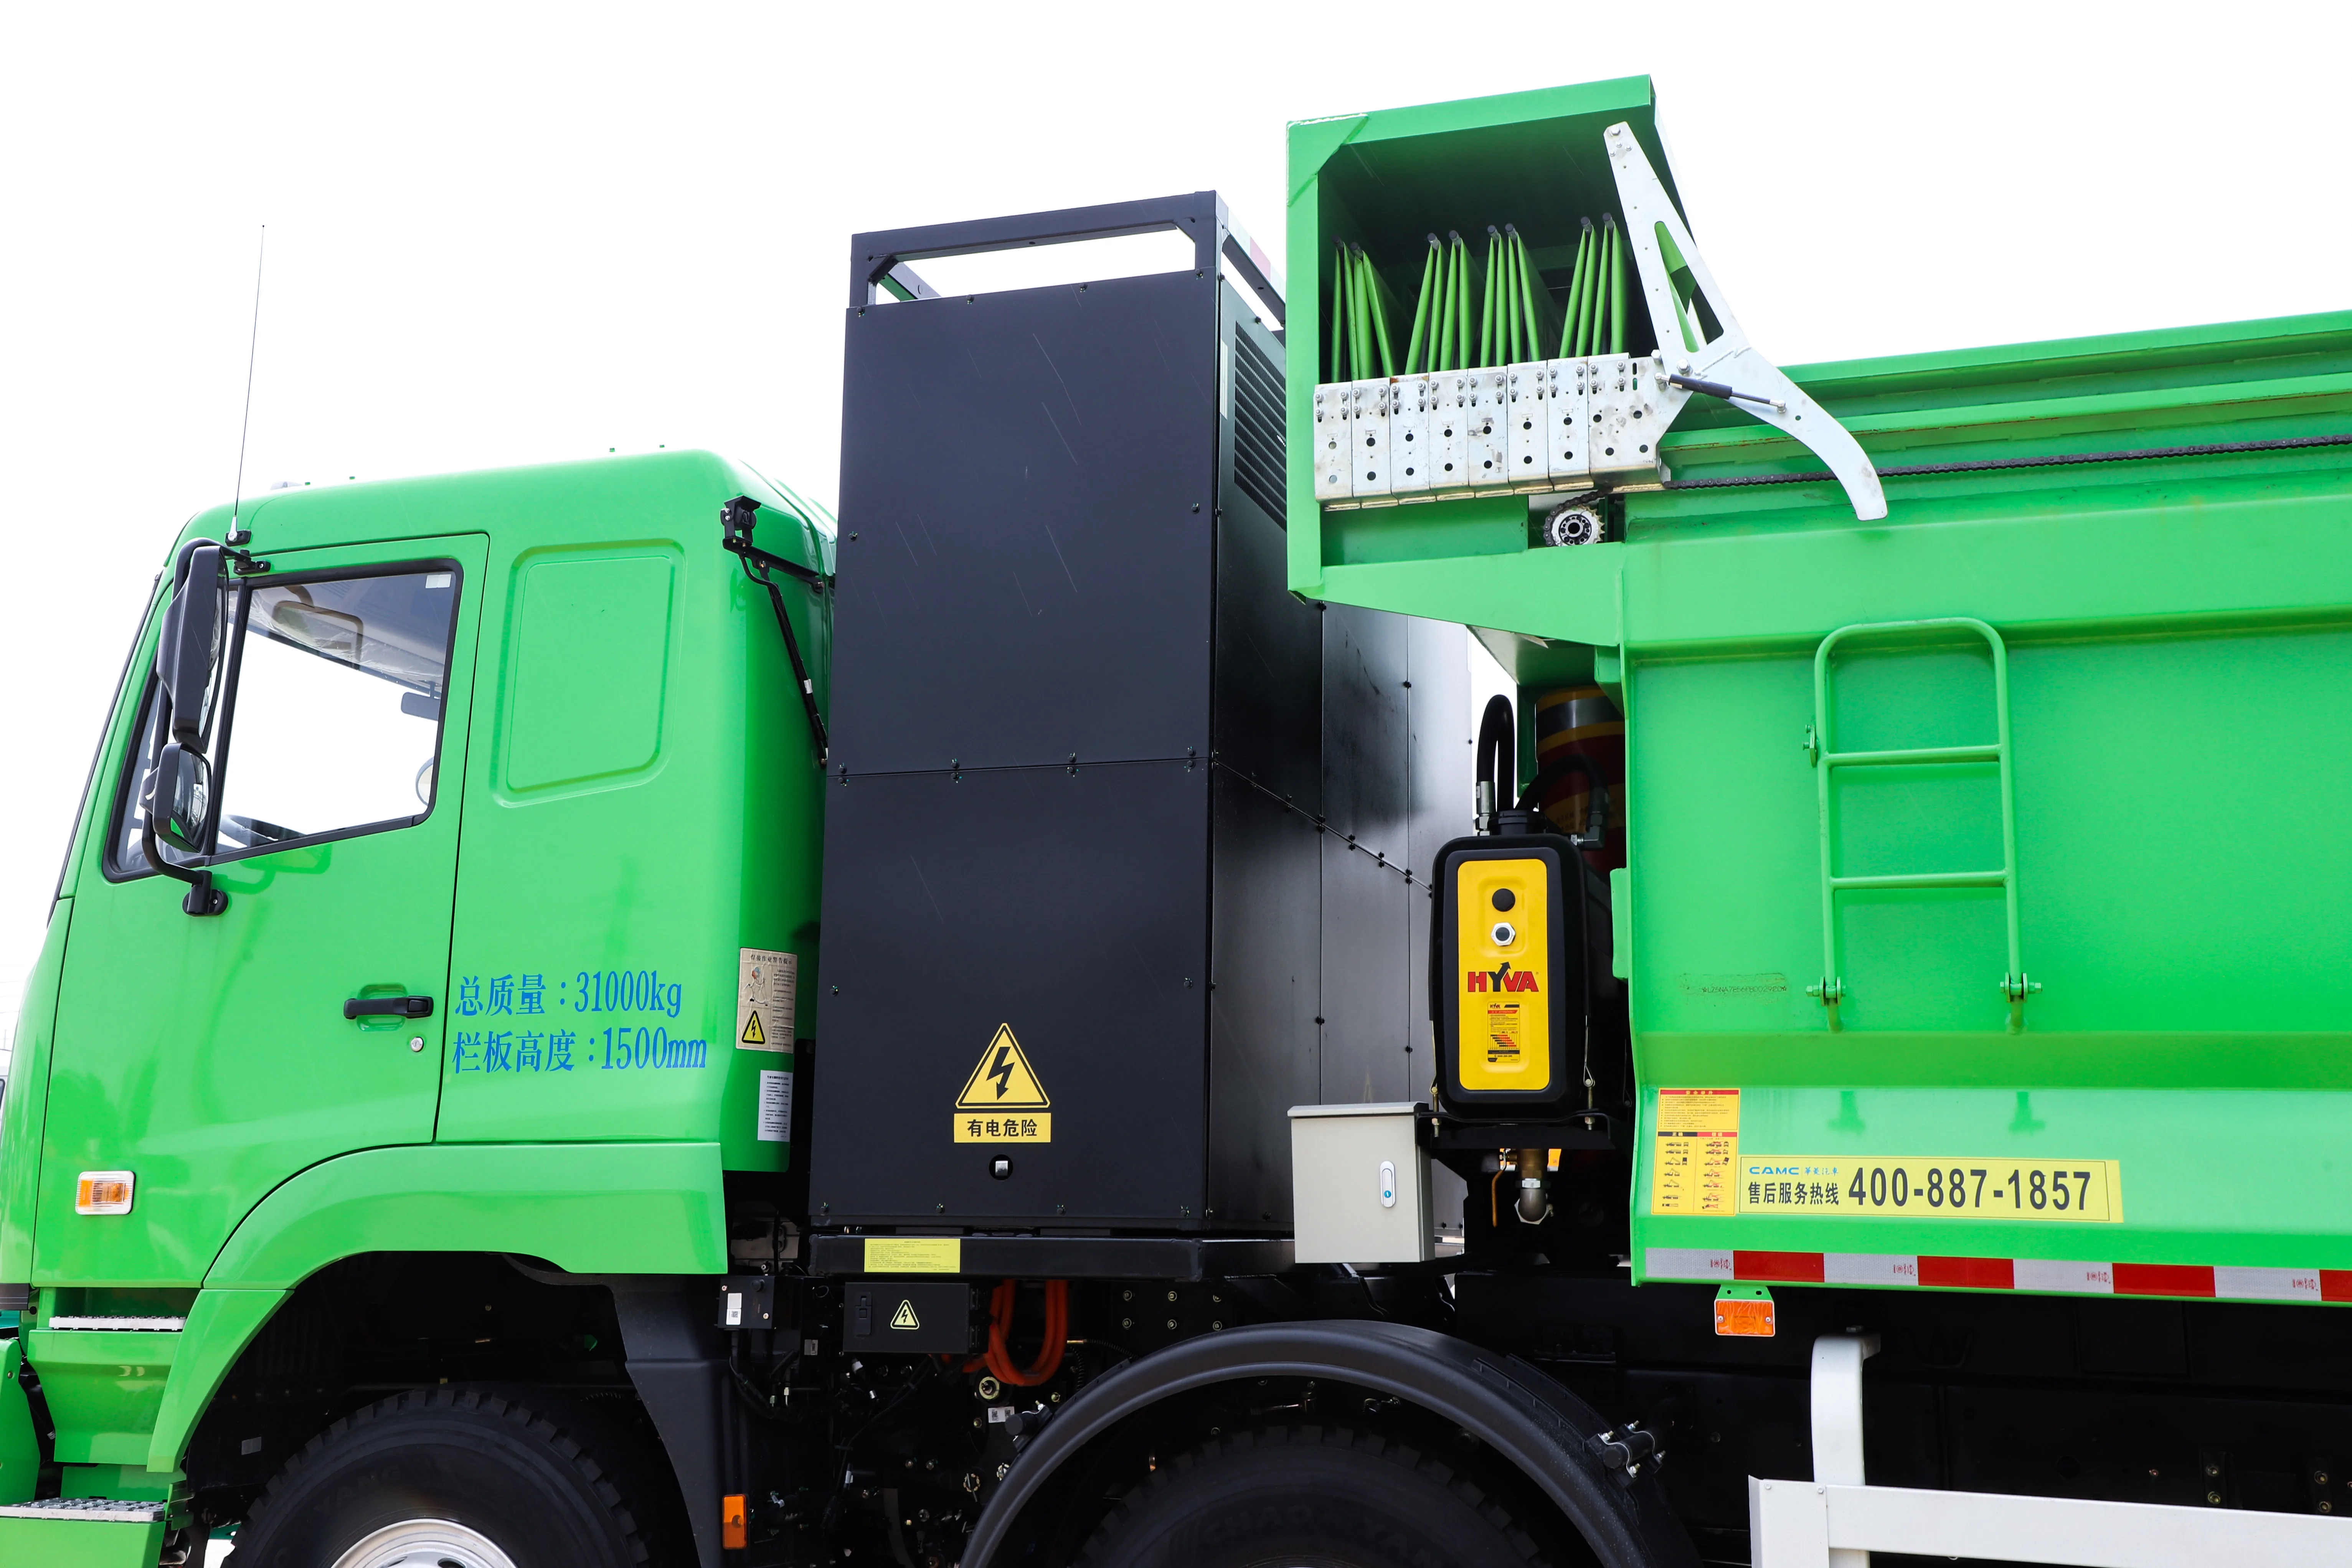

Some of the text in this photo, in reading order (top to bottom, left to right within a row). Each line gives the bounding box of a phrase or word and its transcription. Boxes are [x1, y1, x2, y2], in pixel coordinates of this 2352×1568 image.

[750, 954, 792, 965] 焊接作业警告提示
[1467, 962, 1539, 992] HYVA
[967, 1119, 1038, 1137] 有电危险
[1749, 1167, 1799, 1175] CAMC
[1748, 1167, 2091, 1210] 售后服务热线 400-887-1857
